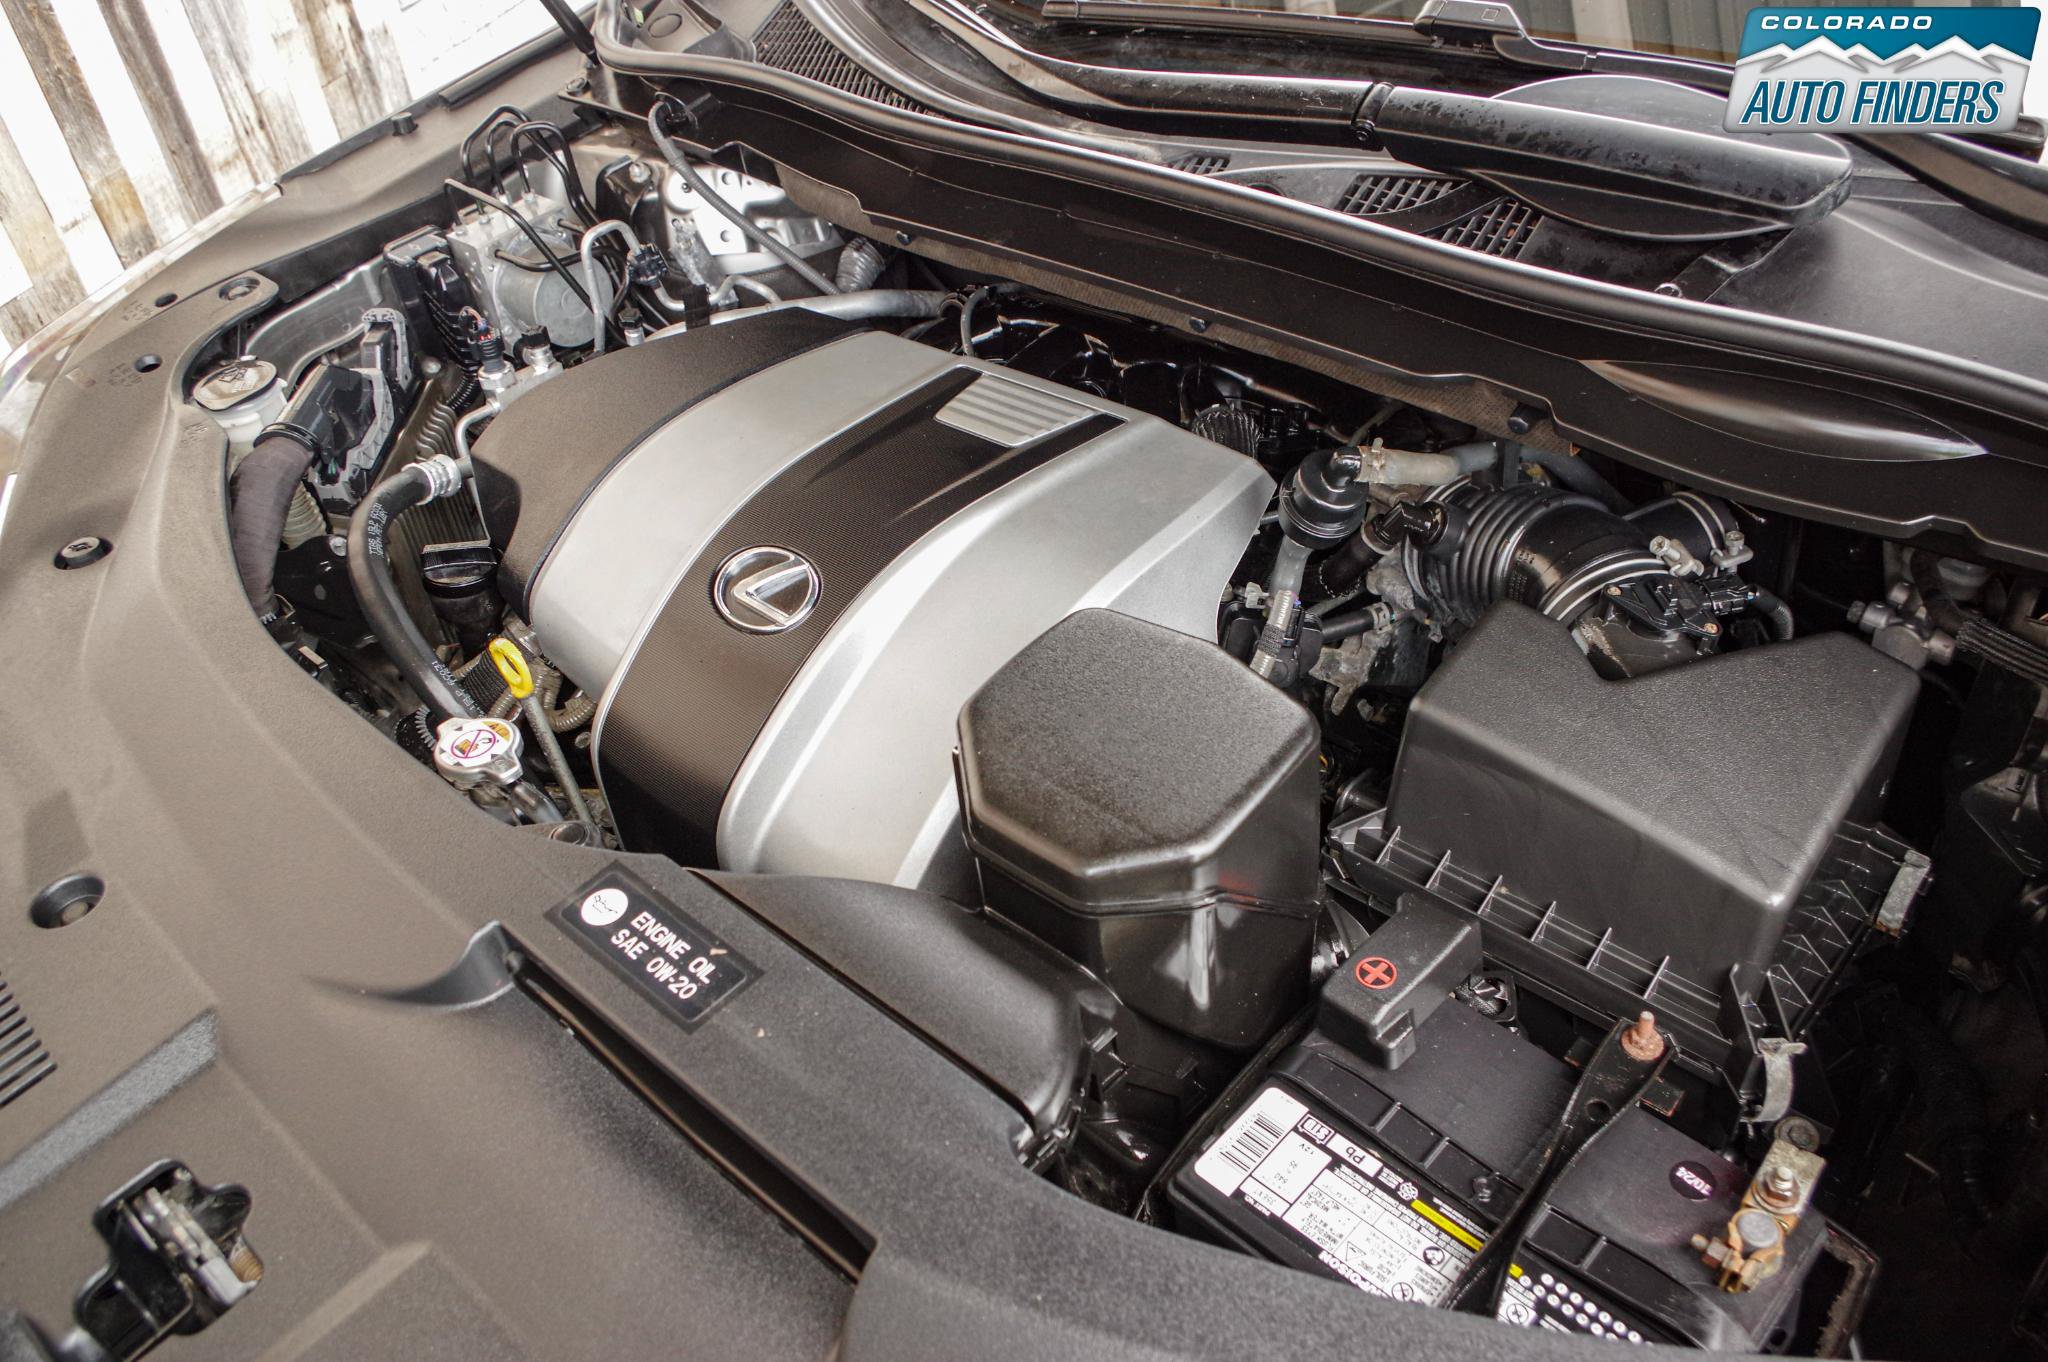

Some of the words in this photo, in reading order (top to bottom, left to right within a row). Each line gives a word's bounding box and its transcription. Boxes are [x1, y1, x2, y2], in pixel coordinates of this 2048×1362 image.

[611, 929, 649, 960] SAE
[646, 958, 697, 999] 0W-20
[630, 911, 691, 960] ENGINE
[689, 957, 718, 984] OIL
[1345, 1146, 1364, 1164] Pb
[1675, 1166, 1713, 1195] 10/24
